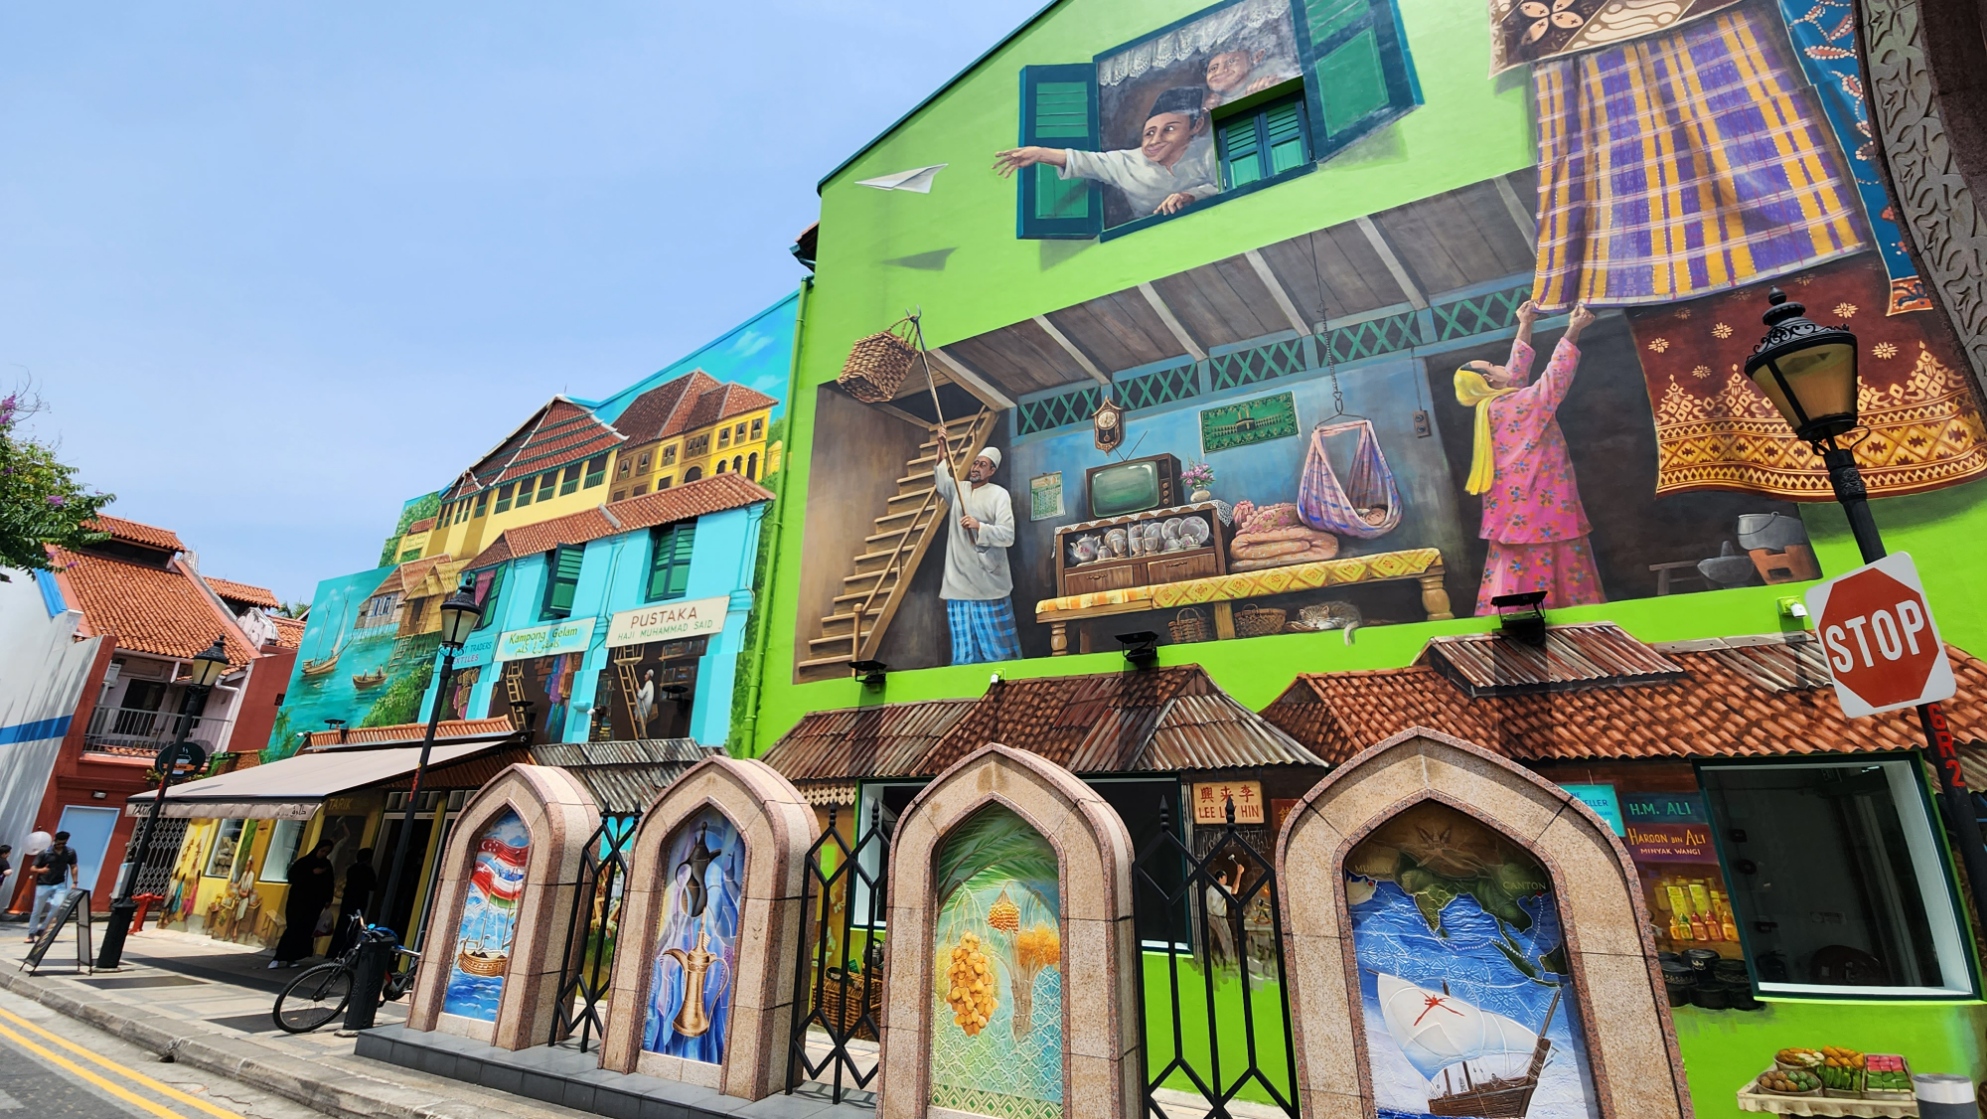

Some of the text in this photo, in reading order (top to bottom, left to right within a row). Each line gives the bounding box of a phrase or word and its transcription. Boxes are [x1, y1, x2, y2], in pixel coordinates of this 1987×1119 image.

[631, 607, 697, 629] PUSTAKA
[509, 626, 578, 645] Kampong Gelam
[617, 619, 713, 641] HAJI MUHAMMAD SAID
[1825, 599, 1924, 673] STOP
[470, 641, 492, 653] TRADERS
[453, 654, 479, 665] EXTILES
[328, 797, 353, 810] TARIK
[1629, 802, 1692, 815] H.M. ALI
[1199, 806, 1216, 818] LEE
[1241, 805, 1259, 818] HIN
[1627, 828, 1668, 846] HAROON
[1686, 829, 1706, 846] ALI
[1674, 848, 1702, 856] WANGI
[1502, 881, 1547, 890] CANTON
